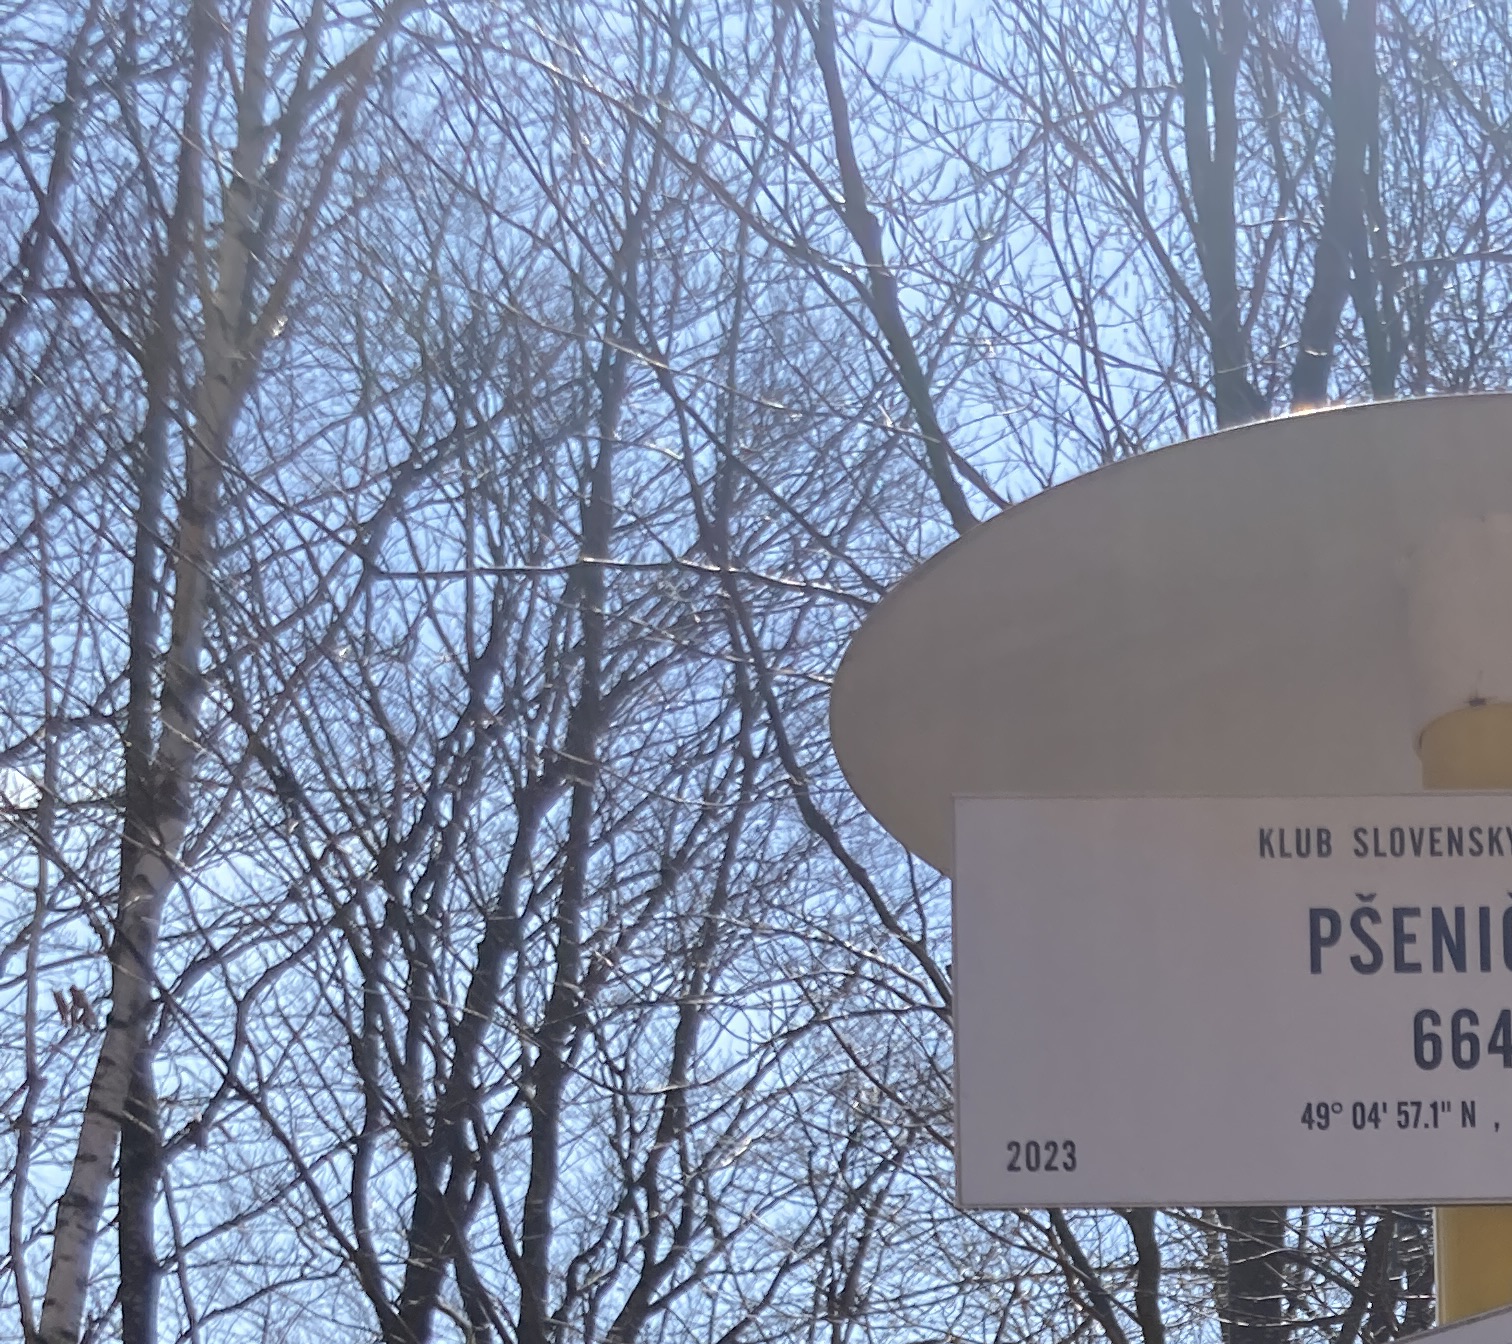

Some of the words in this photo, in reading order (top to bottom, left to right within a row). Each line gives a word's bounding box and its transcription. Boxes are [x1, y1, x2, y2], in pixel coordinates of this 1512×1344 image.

[1258, 827, 1333, 859] KLUB
[1460, 1100, 1477, 1129] N
[1006, 1139, 1077, 1173] 2023
